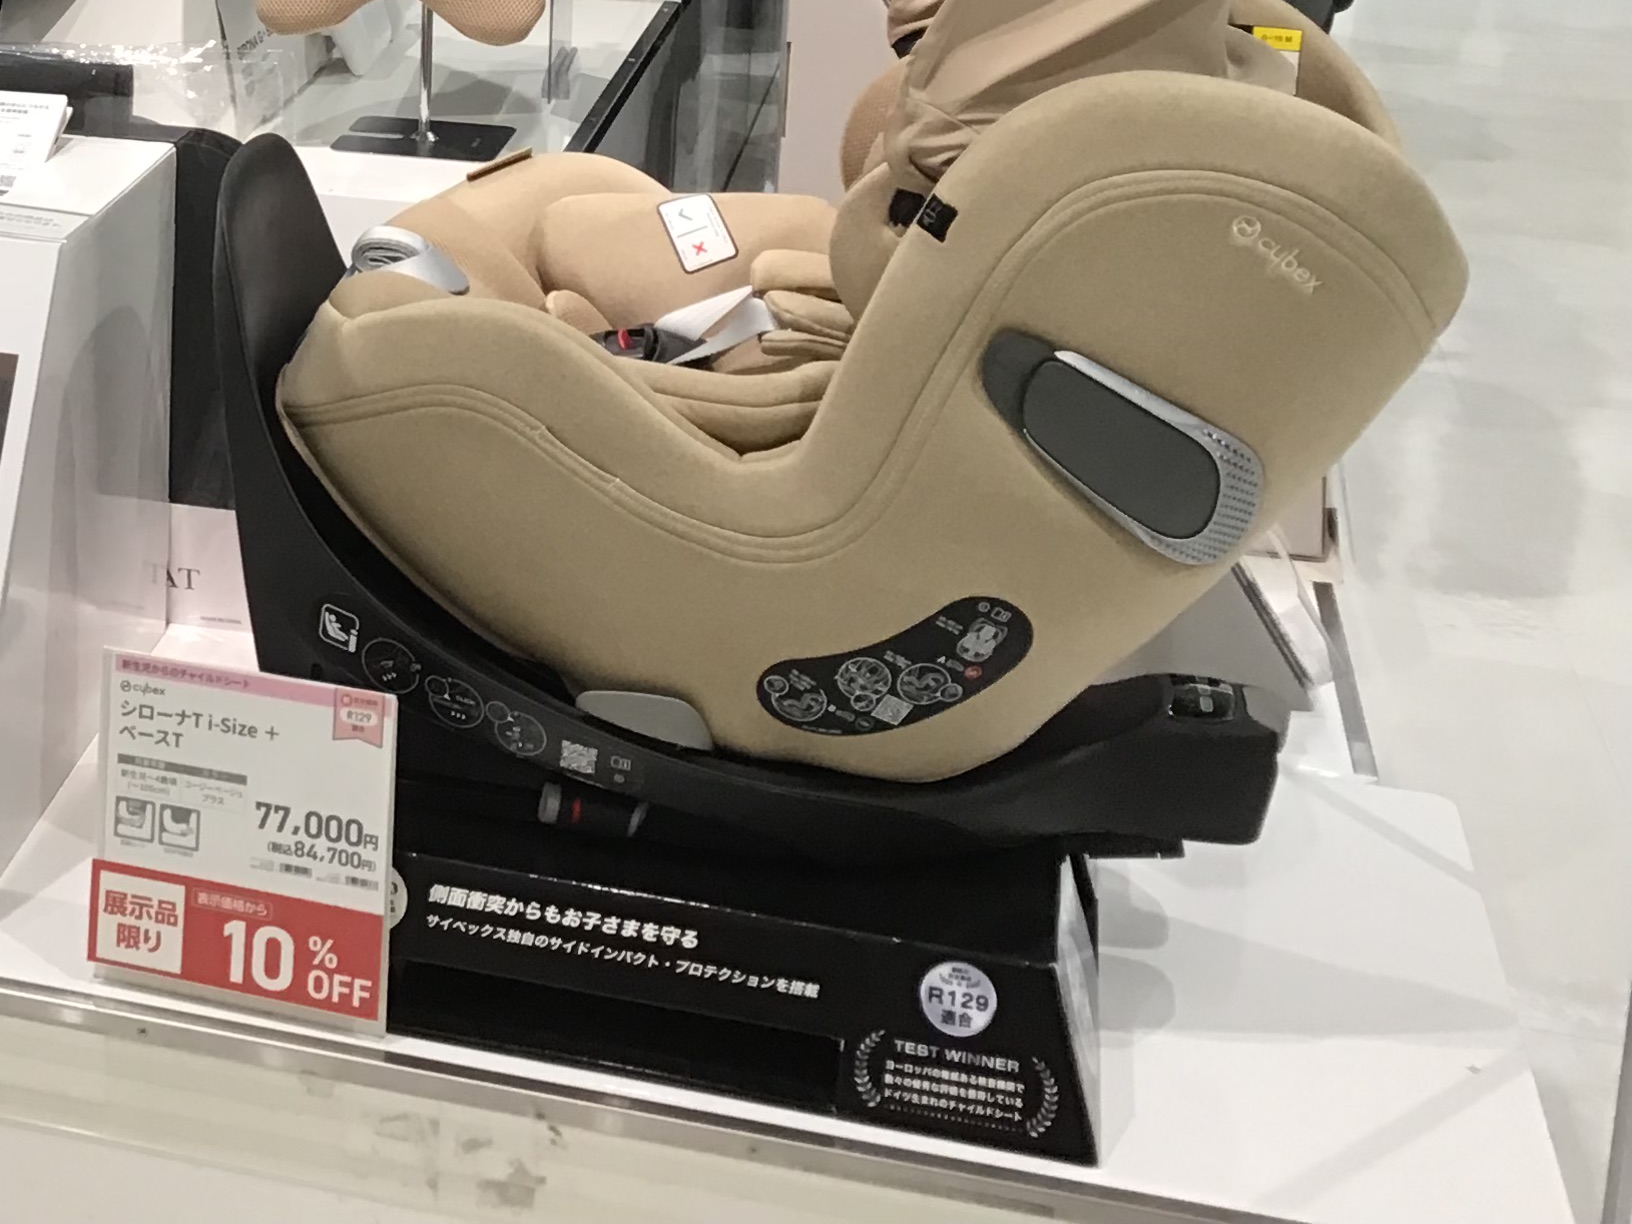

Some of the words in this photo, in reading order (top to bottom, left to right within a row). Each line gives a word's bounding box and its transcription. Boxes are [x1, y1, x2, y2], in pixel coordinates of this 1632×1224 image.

[1257, 237, 1323, 294] cybex
[132, 682, 166, 697] cybex
[207, 713, 258, 739] i-Size
[346, 709, 373, 723] R129
[119, 725, 184, 748] ベースT
[255, 800, 379, 852] 77,000円
[103, 889, 179, 927] 展示品
[196, 891, 268, 918] 表示価格から
[428, 883, 700, 949] 側面衝突からもお子さまを守る
[116, 922, 162, 953] 限り
[223, 919, 295, 992] 10
[308, 935, 338, 969] %
[307, 969, 372, 1008] OFF
[928, 985, 989, 1012] R129
[941, 1009, 973, 1028] 適合
[895, 1039, 940, 1058] TEST
[945, 1048, 1020, 1073] WINNER
